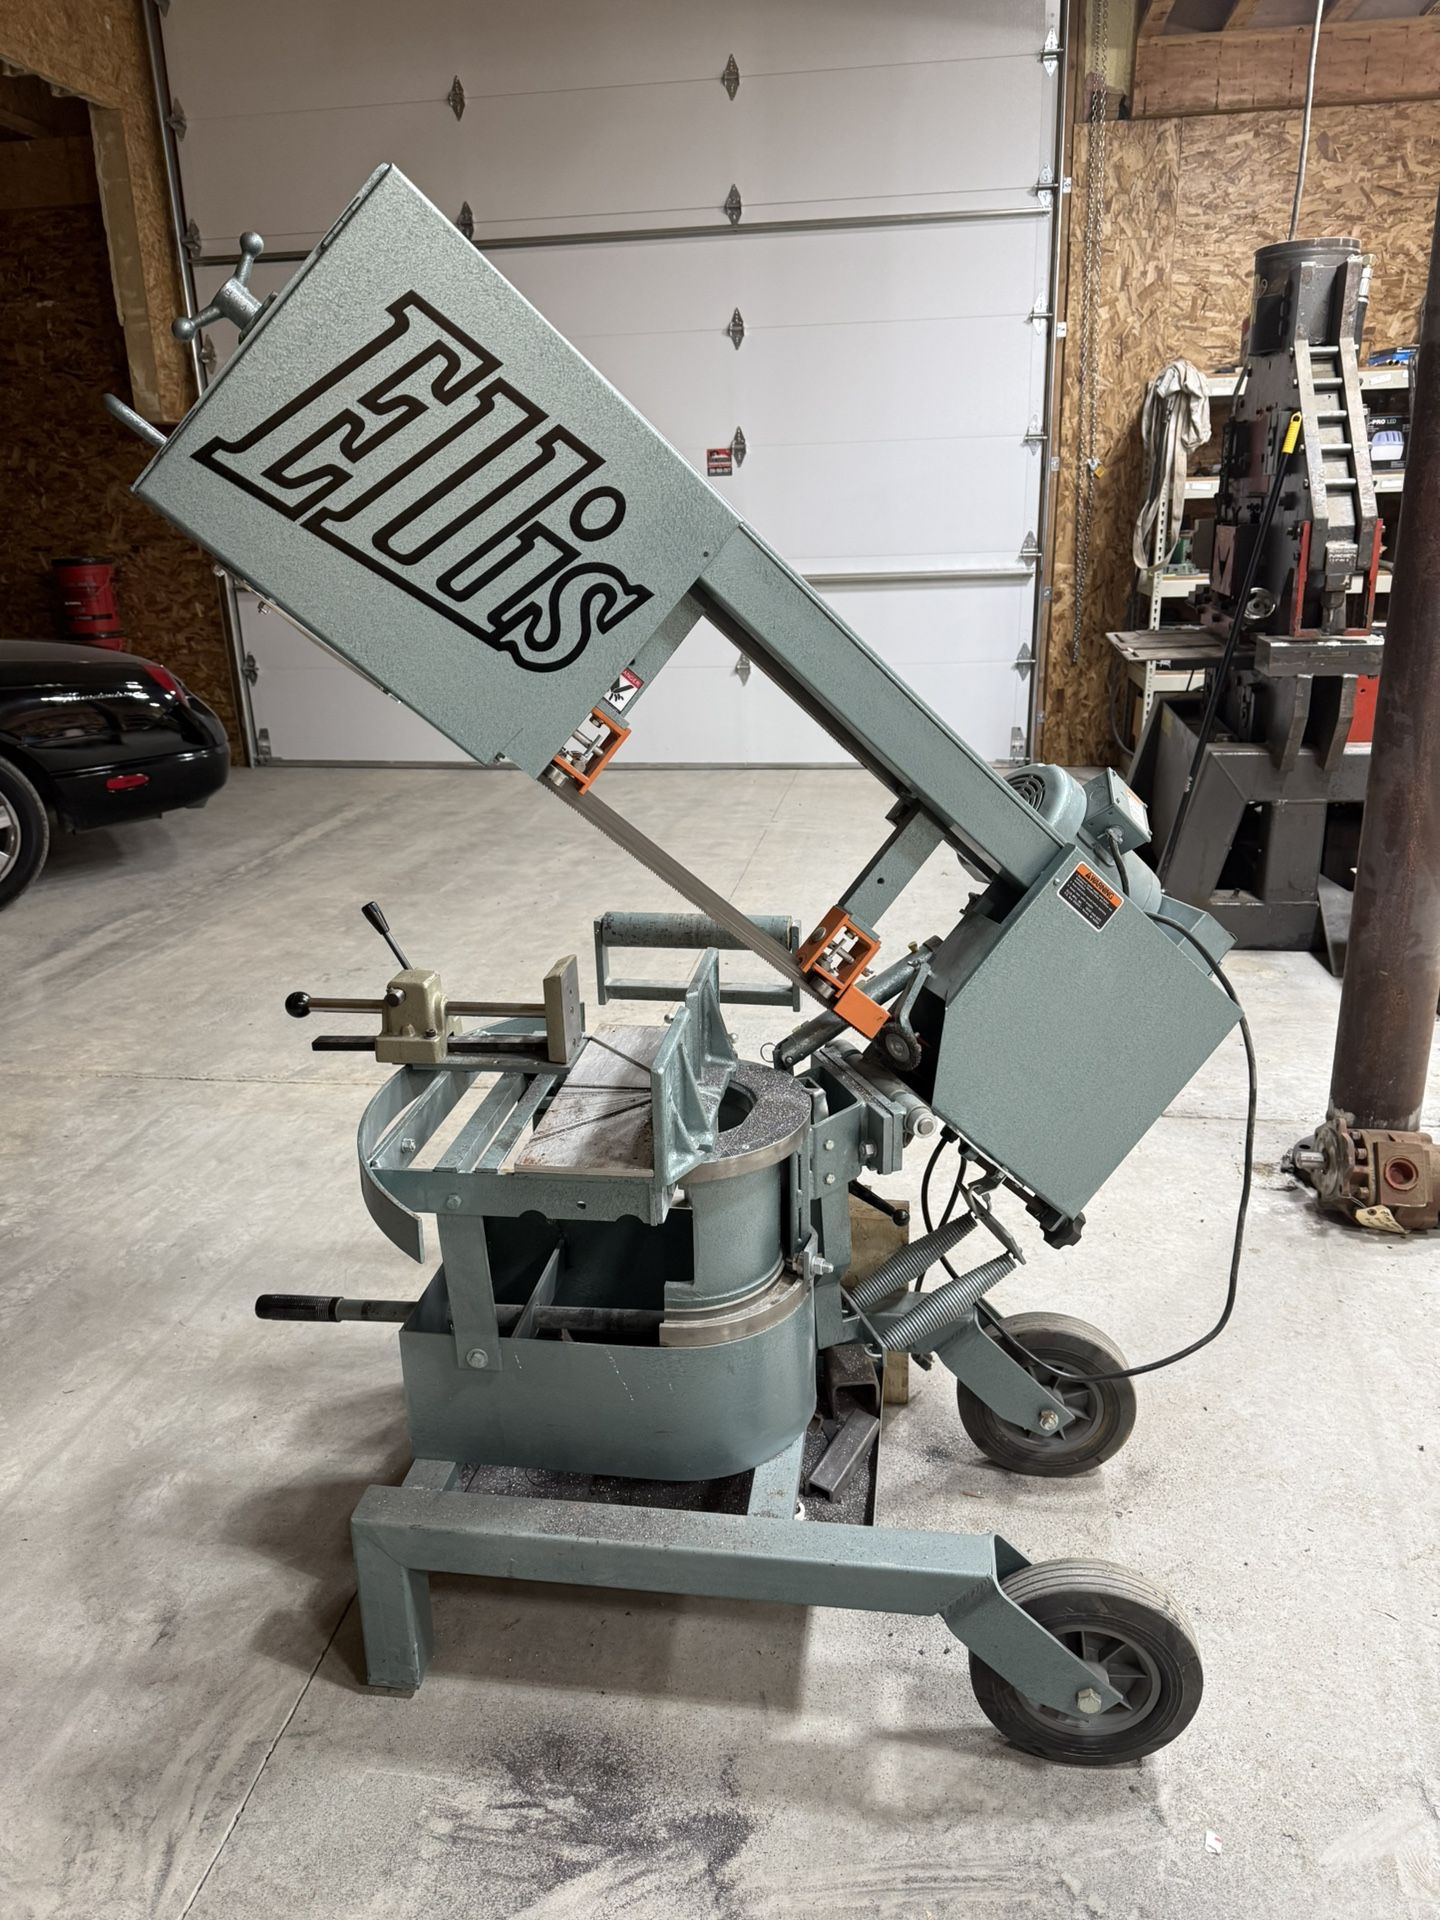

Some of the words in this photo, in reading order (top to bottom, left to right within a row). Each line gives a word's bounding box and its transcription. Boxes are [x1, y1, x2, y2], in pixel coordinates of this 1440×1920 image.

[190, 289, 655, 673] Ellis
[623, 669, 643, 688] ANGER
[1089, 872, 1115, 900] WARNING
